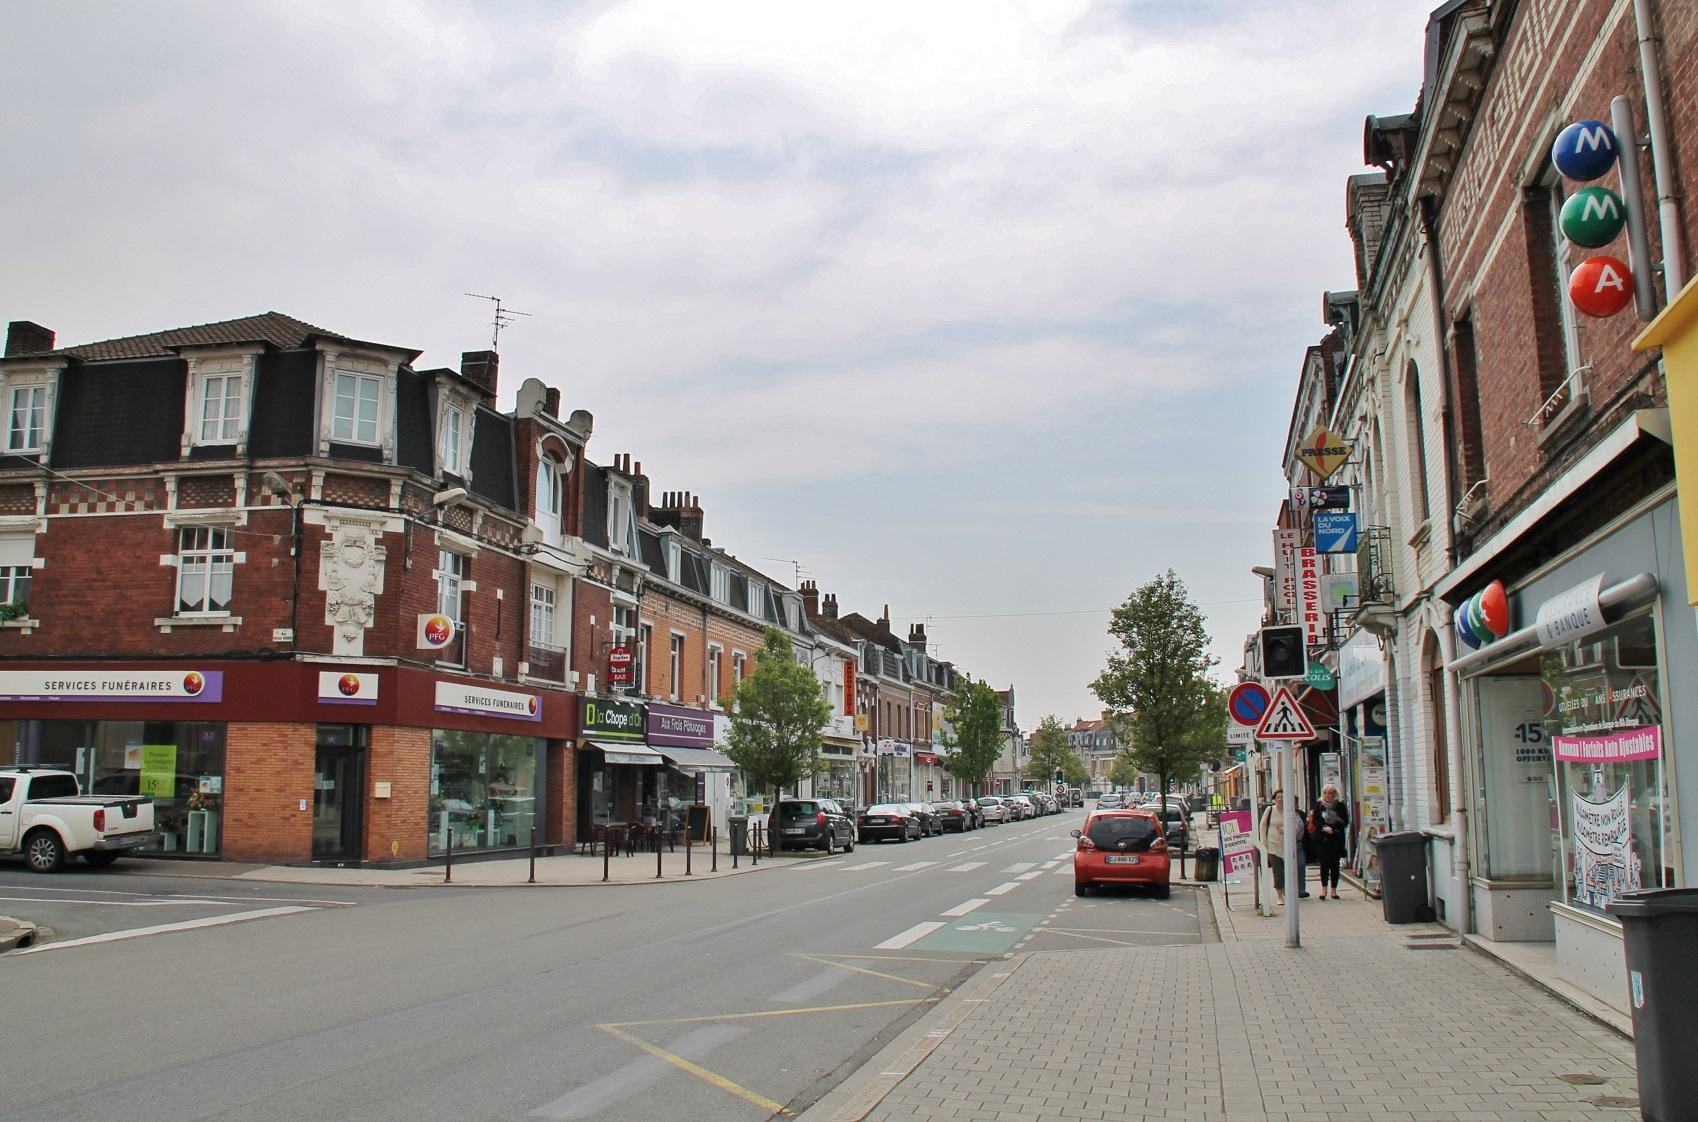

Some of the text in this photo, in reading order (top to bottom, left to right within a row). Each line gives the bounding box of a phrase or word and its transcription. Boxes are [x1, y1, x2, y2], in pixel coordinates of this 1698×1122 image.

[1302, 447, 1346, 457] PRESSE
[1301, 548, 1318, 644] BRASSERIE
[1554, 607, 1591, 636] BANQUE
[429, 632, 445, 641] PFG
[1304, 673, 1331, 682] COLIS
[44, 679, 173, 691] SERVICES FUNÉRAIRES
[464, 695, 492, 707] SERVICES
[605, 709, 628, 729] Chope
[660, 717, 671, 729] Aux
[1558, 739, 1579, 757] Nouveau
[1583, 740, 1604, 758] Forfaits
[1605, 740, 1618, 757] Auto
[1618, 733, 1654, 757] Ajustables
[1222, 822, 1235, 835] ICI
